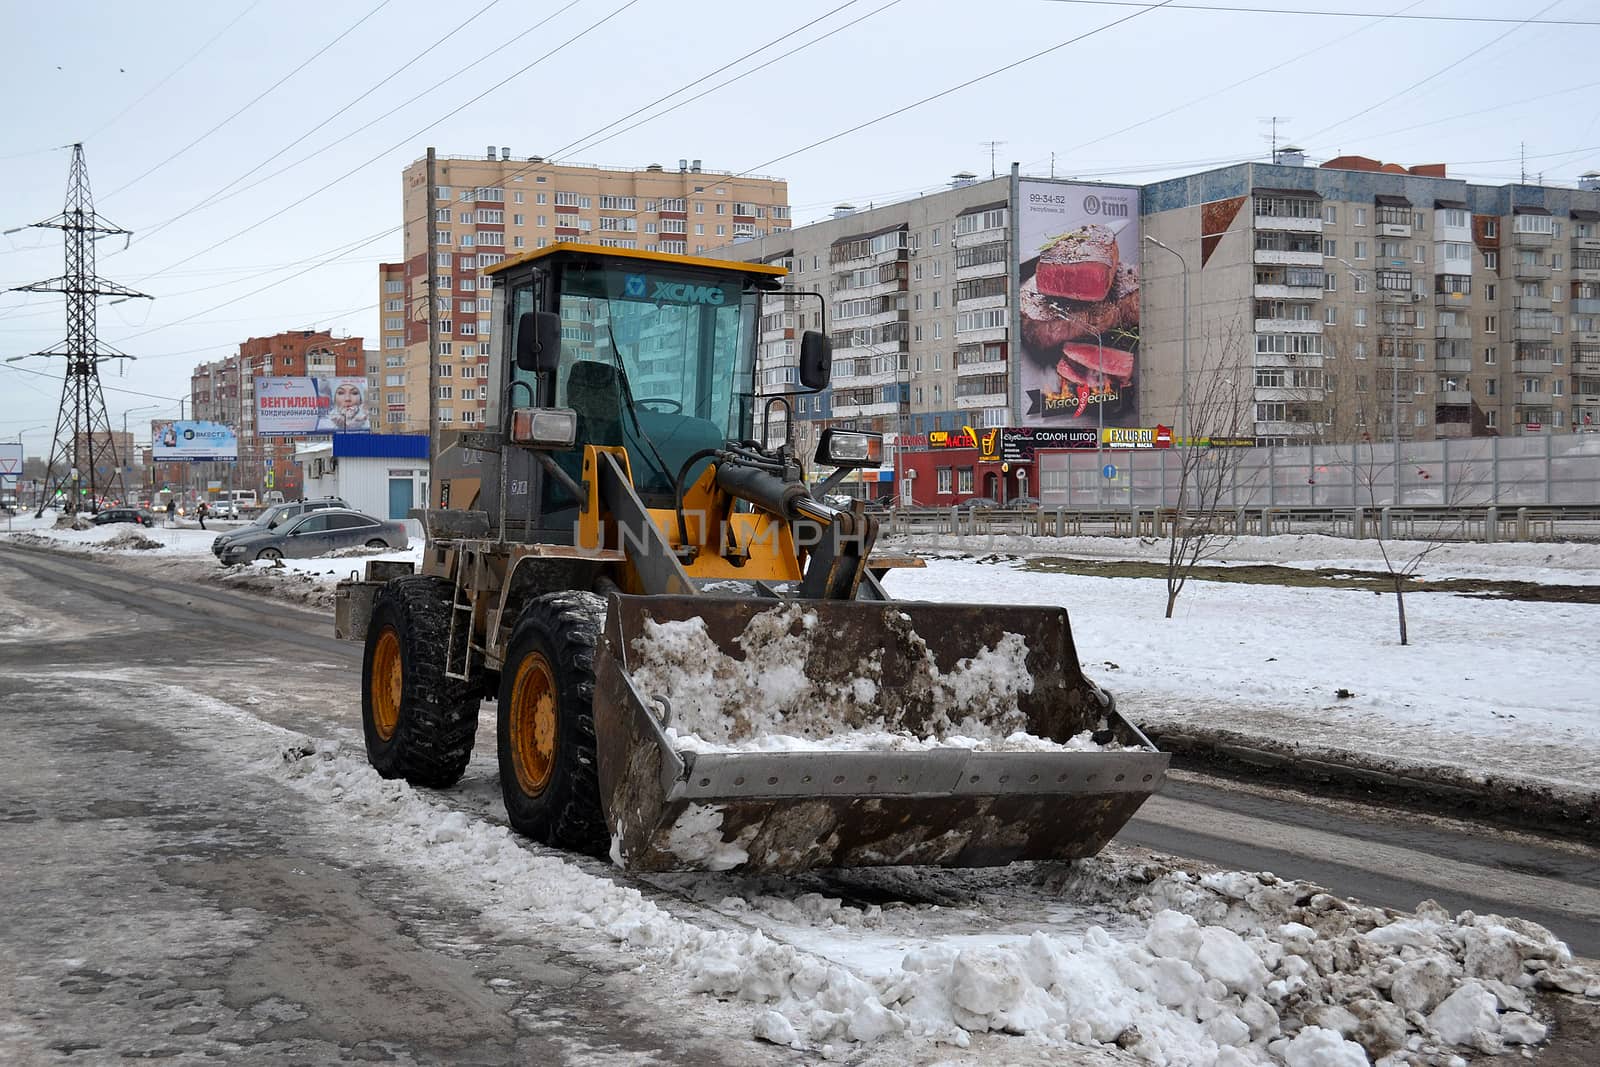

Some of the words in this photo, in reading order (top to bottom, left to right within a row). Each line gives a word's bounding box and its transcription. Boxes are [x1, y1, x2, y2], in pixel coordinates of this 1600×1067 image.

[1030, 194, 1065, 204] 99-34-52
[652, 281, 724, 305] XCMG
[260, 396, 330, 409] ВЕНТИЛЯЦИЯ
[1045, 397, 1079, 410] Мясо
[1087, 391, 1119, 404] есть!
[1110, 429, 1153, 441] EXLUB.RU
